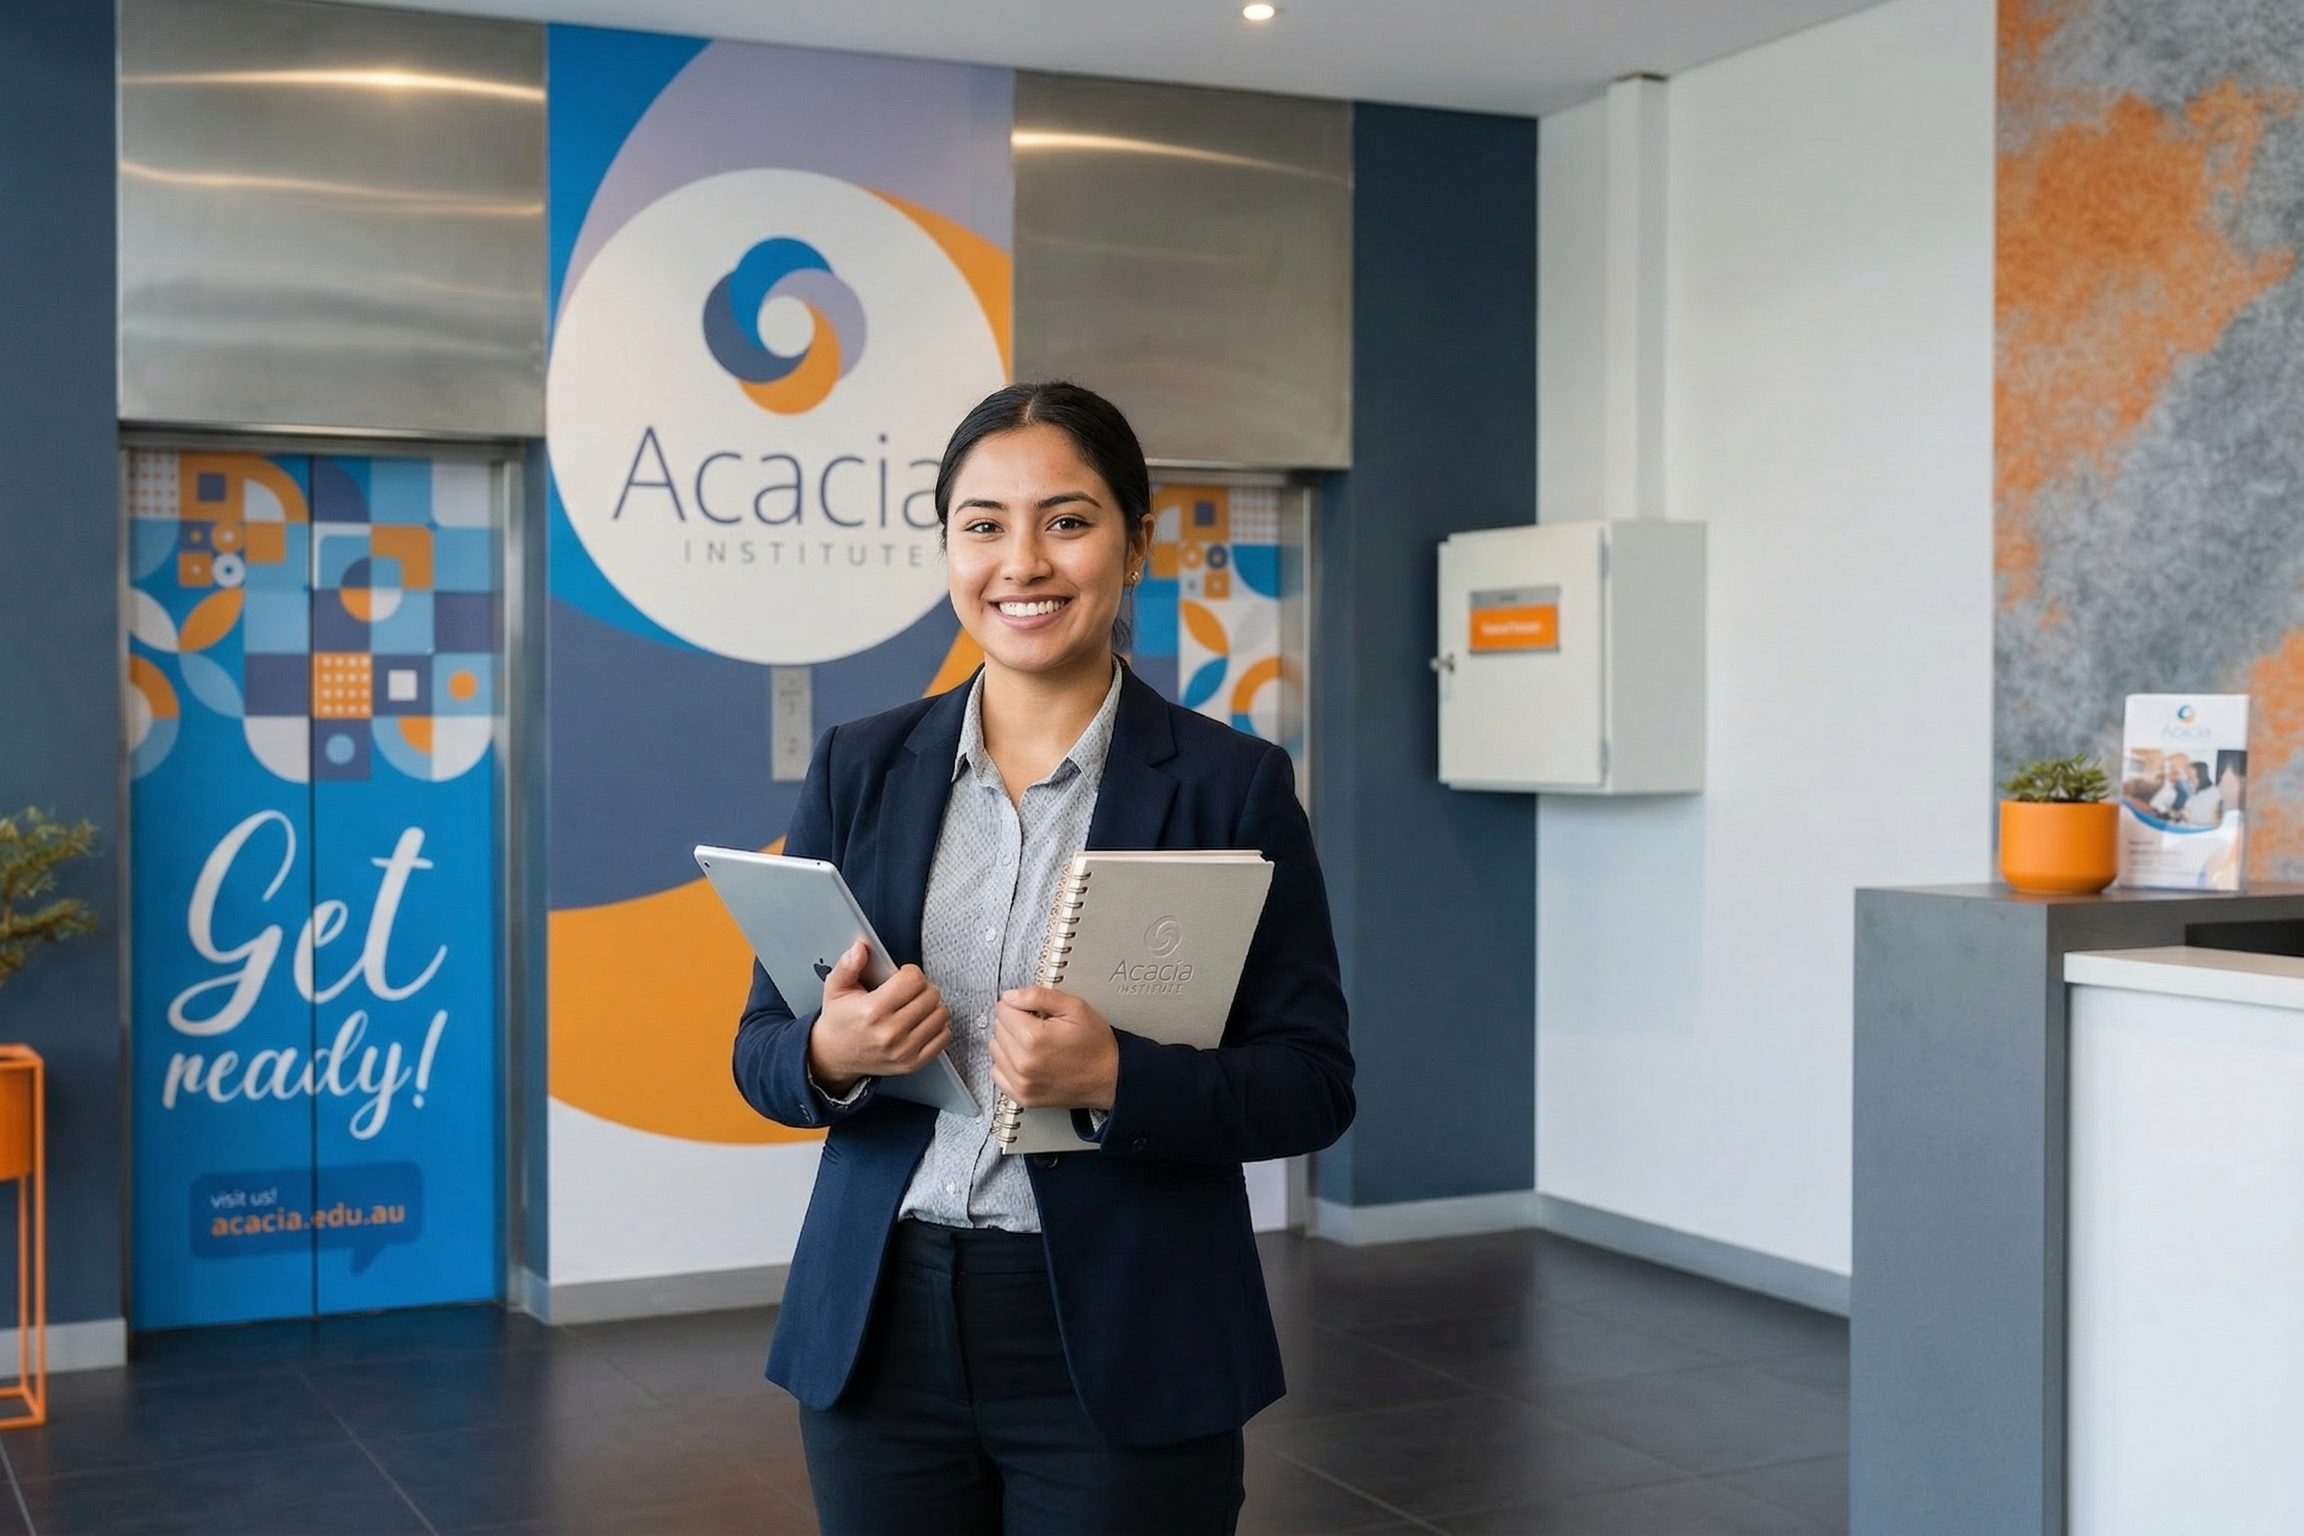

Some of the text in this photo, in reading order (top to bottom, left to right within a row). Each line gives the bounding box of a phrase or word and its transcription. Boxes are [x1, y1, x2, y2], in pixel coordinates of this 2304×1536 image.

[612, 425, 942, 531] Acacia
[684, 541, 923, 567] INSTITUTE
[167, 809, 448, 1036] Get
[1109, 959, 1194, 983] Acacia
[162, 1009, 448, 1141] ready!
[210, 1187, 278, 1209] visit us!
[211, 1201, 406, 1237] acacia.edu.au
